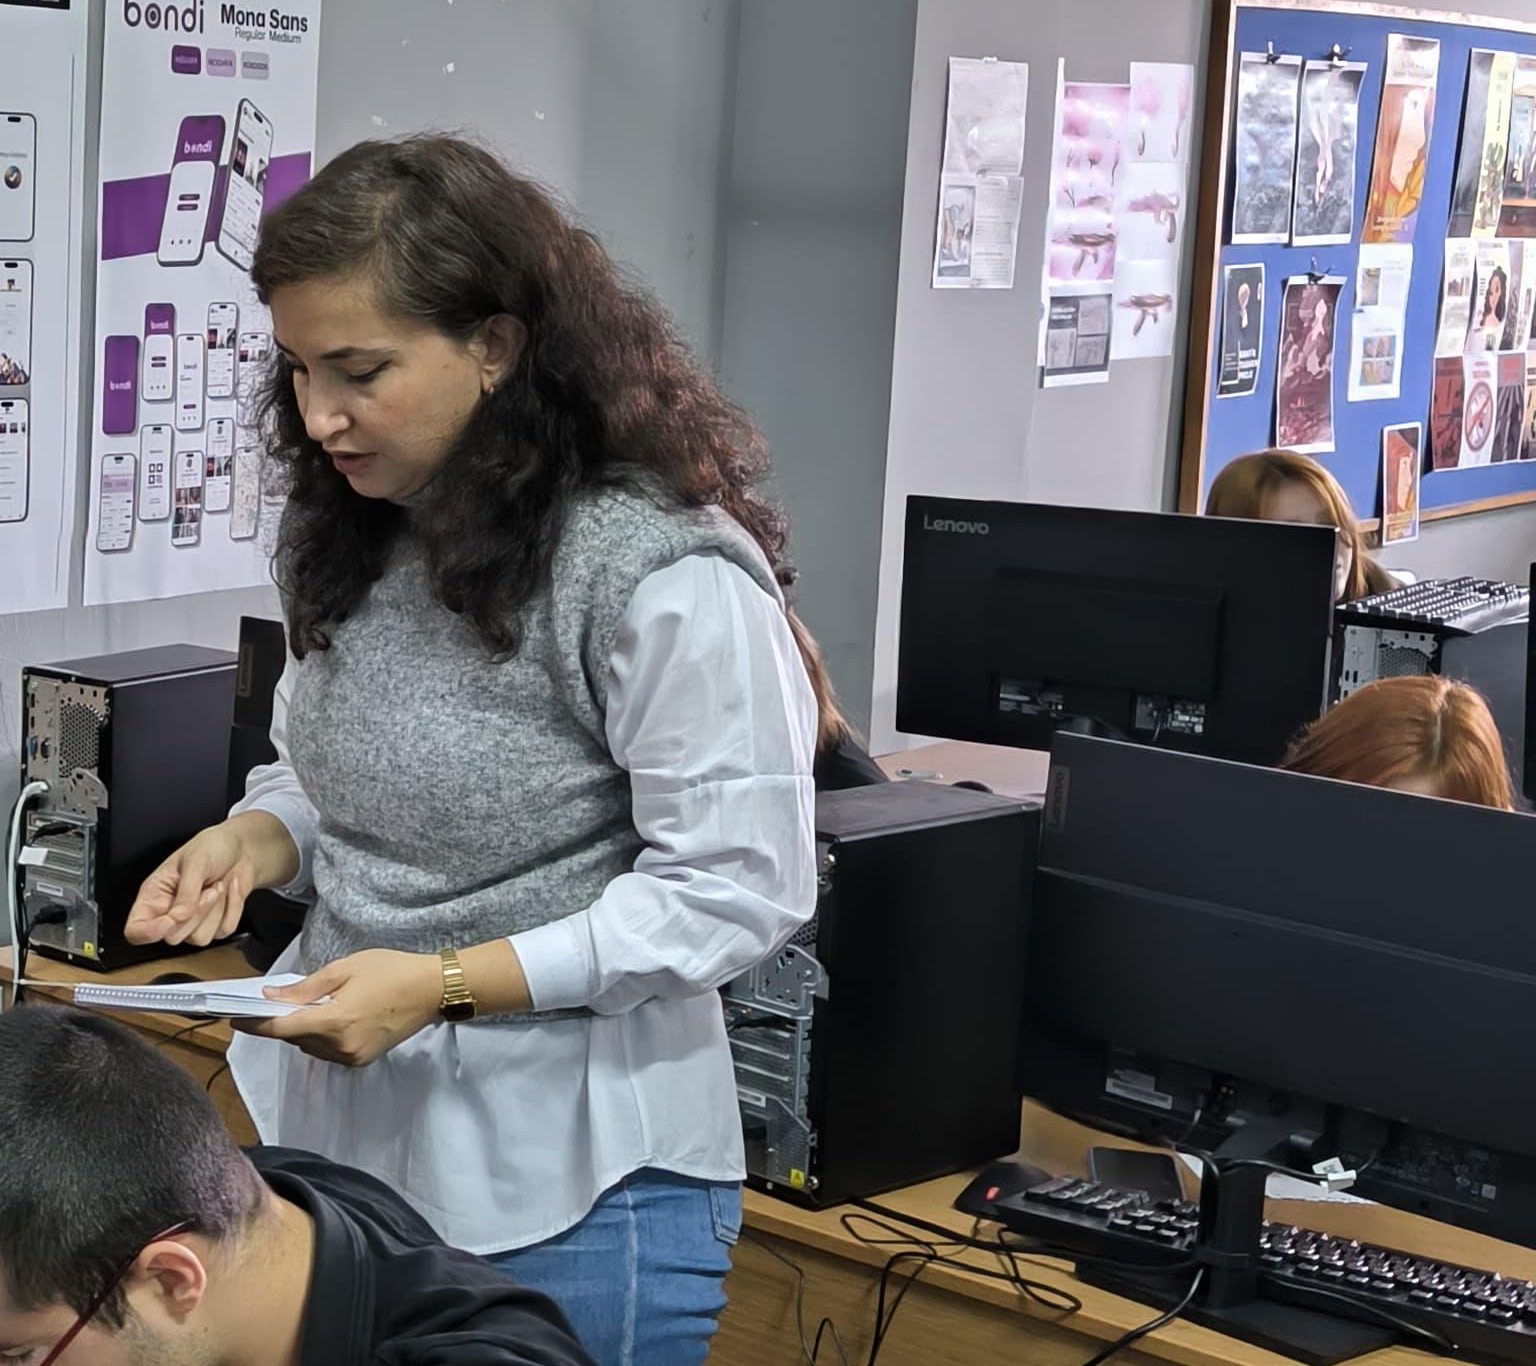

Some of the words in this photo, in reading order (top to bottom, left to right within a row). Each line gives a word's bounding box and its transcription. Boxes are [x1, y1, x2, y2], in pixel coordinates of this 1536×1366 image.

[221, 3, 265, 28] Mona
[269, 9, 308, 32] Sans
[269, 29, 302, 44] Medium
[923, 513, 990, 535] Lenovo
